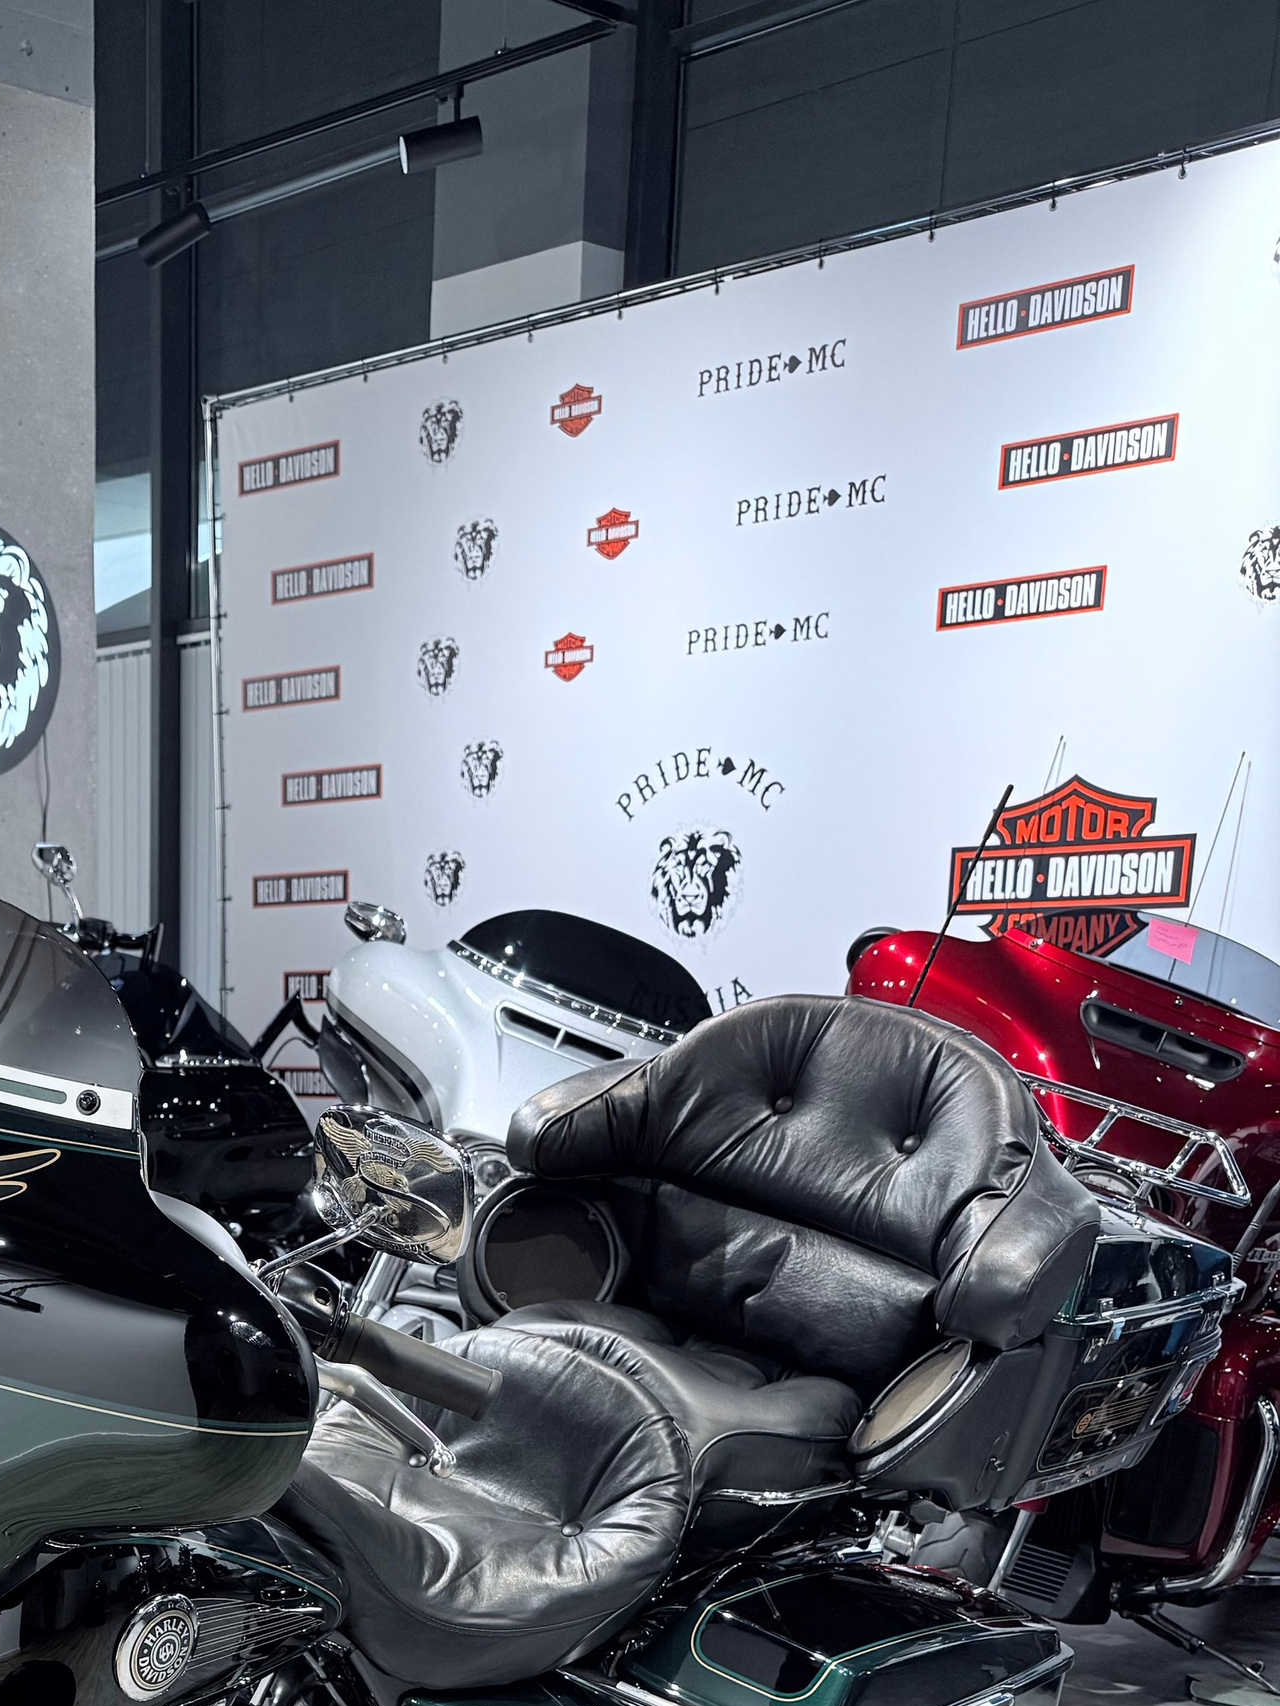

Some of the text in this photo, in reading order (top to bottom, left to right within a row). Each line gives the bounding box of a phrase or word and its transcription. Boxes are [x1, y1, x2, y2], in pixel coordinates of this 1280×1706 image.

[967, 275, 1123, 341] HELLO DAVIDSON
[697, 338, 847, 397] PRIDE MC
[243, 447, 335, 492] HELLO DAVIDSON
[1009, 423, 1168, 482] HELLO DAVIDSON
[736, 474, 886, 526] PRIDE MC
[276, 559, 368, 600] HELLO DAVIDSON
[946, 573, 1097, 624] HELLO DAVIDSON
[686, 611, 829, 655] PRIDE MC
[247, 671, 336, 707] HELLO DAVIDSON
[286, 769, 377, 802] HELLO DAVIDSON
[615, 746, 785, 821] PRIDE MC
[1016, 794, 1130, 843] MOTOR
[257, 875, 344, 903] HELLO DAVIDSON
[966, 851, 1175, 901] HELLO DAVIDSON
[144, 1618, 189, 1647] HARLEY
[139, 1646, 189, 1683] DAVIDSON
